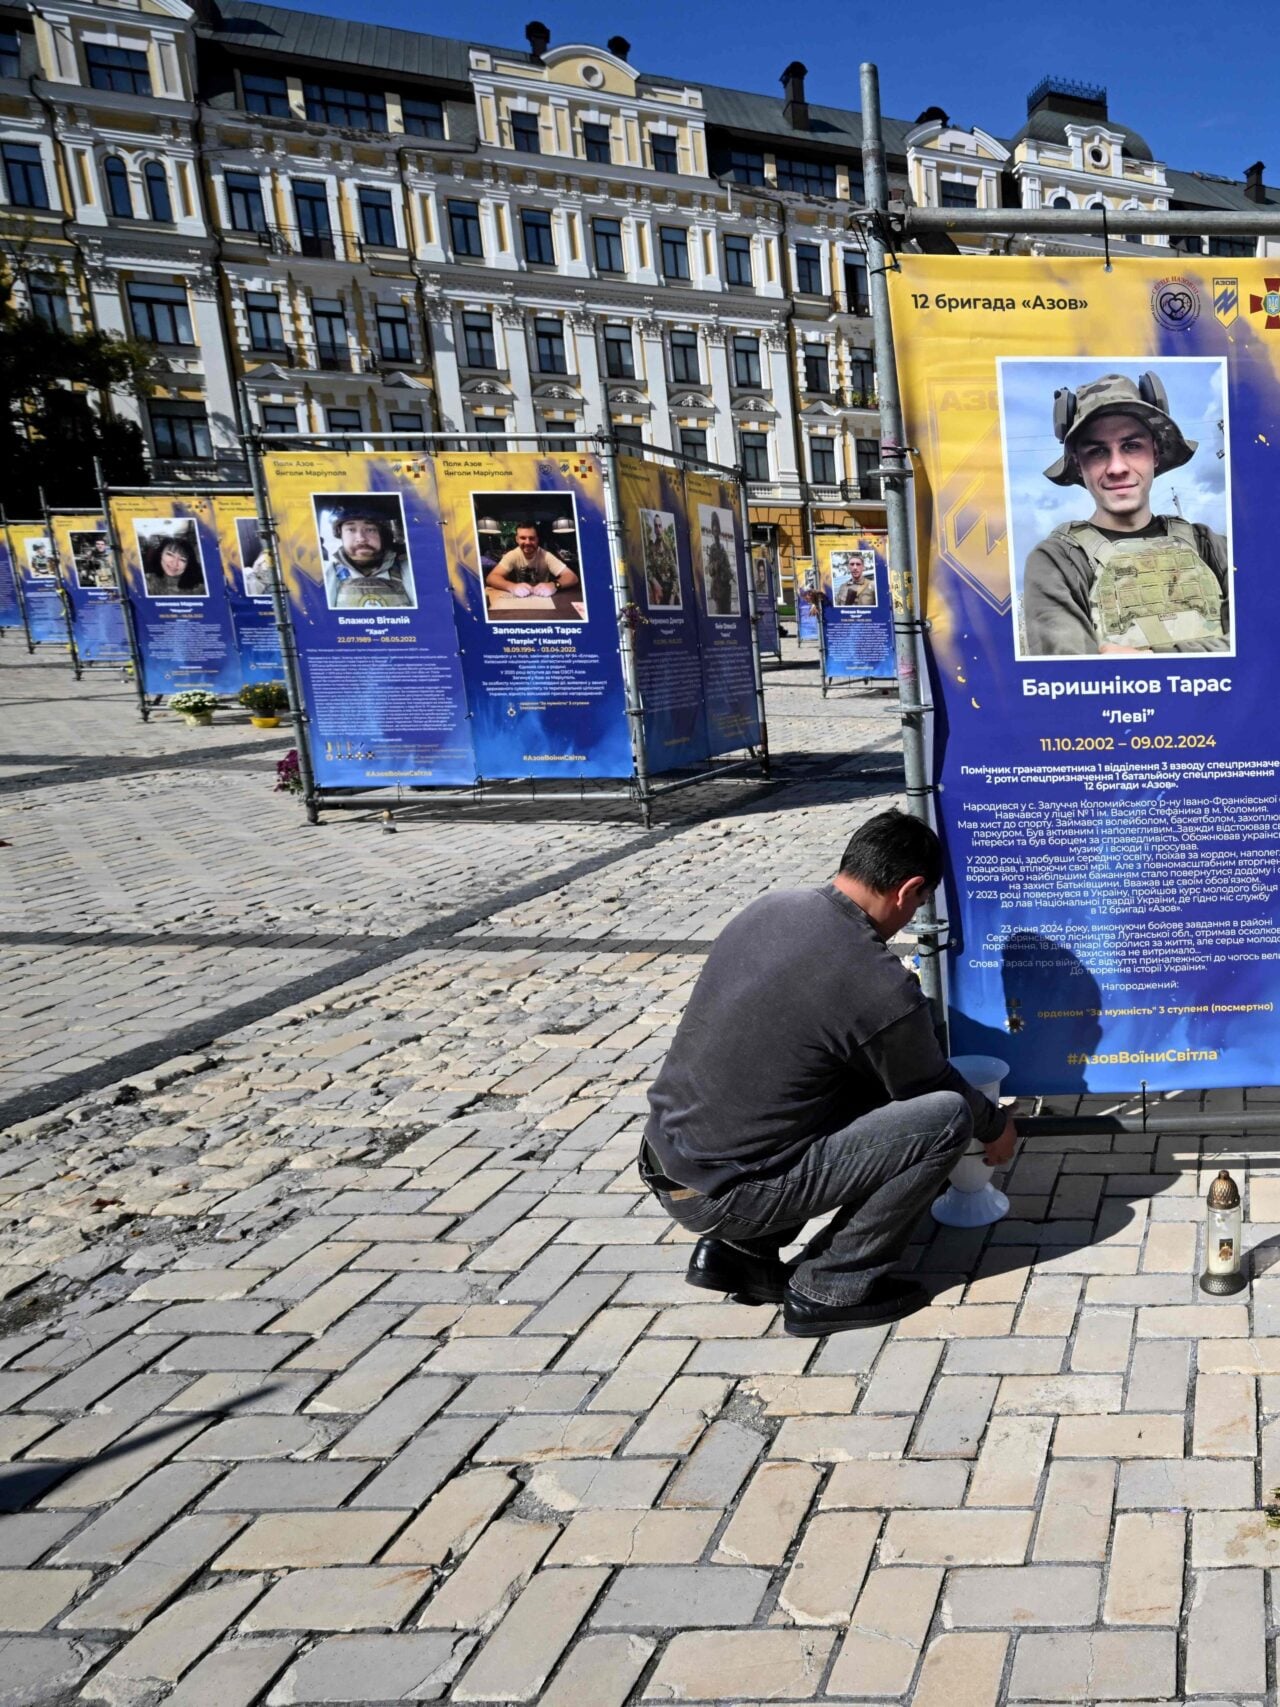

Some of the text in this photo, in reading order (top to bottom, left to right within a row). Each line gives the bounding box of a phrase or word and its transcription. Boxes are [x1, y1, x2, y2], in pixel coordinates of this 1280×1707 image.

[912, 292, 1088, 313] 12 бригада «Азов»
[338, 616, 410, 624] Блажко Віталій
[492, 626, 582, 636] Запольський Тарас
[1022, 675, 1232, 699] Баришніков Тарас
[1039, 738, 1114, 751] 11.10.2002
[1130, 736, 1216, 750] 09.02.2024
[961, 764, 1010, 774] Помічник
[1012, 764, 1096, 775] гранатометника
[1097, 762, 1101, 771] 1
[1104, 761, 1159, 773] відділення
[1161, 761, 1167, 770] 3
[1169, 762, 1204, 772] взводу
[986, 770, 1274, 784] 2 роти спецпризначення 1 батальйону спецпризначення
[1084, 780, 1178, 792] 12 бригади «Азов».
[963, 801, 1018, 812] Народився
[1020, 802, 1026, 811] у
[1038, 800, 1078, 810] Залуччя
[1080, 798, 1157, 808] Коломийського
[1159, 799, 1181, 808] р-ну
[1183, 795, 1277, 807] Івано-Франківської
[995, 810, 1042, 819] Навчався
[1043, 811, 1049, 820] у
[1051, 809, 1074, 819] ліцеї
[1077, 808, 1088, 817] №
[1090, 808, 1094, 817] 1
[1110, 807, 1146, 816] Василя
[1148, 806, 1201, 817] Стефаника
[958, 820, 978, 829] Мав
[1002, 821, 1016, 829] до
[1055, 817, 1103, 826] Займався
[1037, 1002, 1273, 1019] орденом "За мужність" 3 ступеня (посмертно)
[1067, 1049, 1217, 1065] #АзовВоїниСвітла
